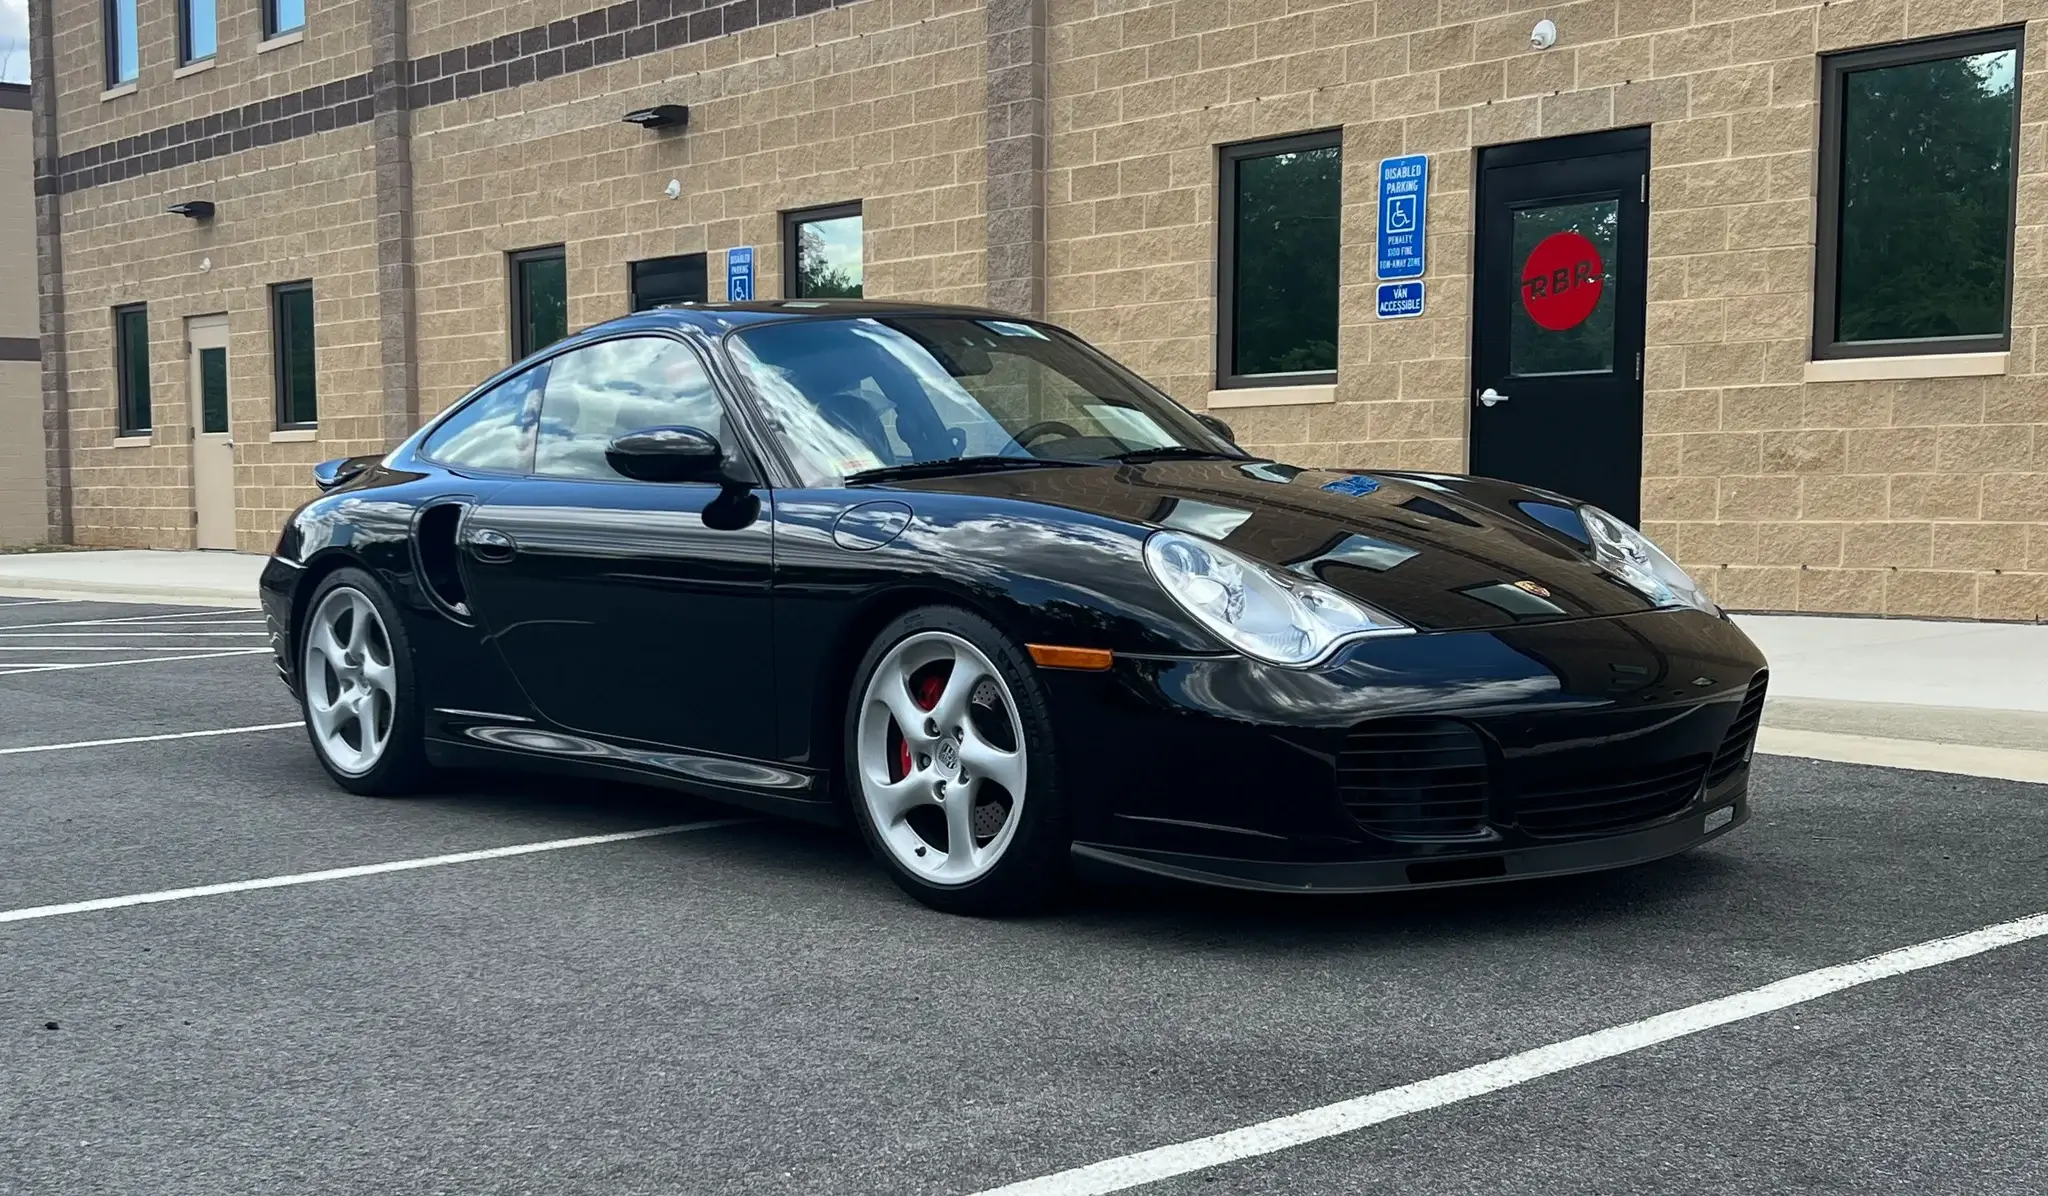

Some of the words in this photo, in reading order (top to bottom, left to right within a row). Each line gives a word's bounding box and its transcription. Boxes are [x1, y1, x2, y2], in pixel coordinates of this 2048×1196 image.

[1385, 164, 1421, 180] DISABLED
[1387, 180, 1418, 194] PARKING
[1388, 234, 1413, 245] PENALTY
[1401, 246, 1413, 256] FINE
[1407, 257, 1421, 267] ZONE
[1521, 260, 1603, 303] RBR
[1393, 287, 1408, 299] VAN
[1380, 298, 1421, 312] ACCESSIBLE
